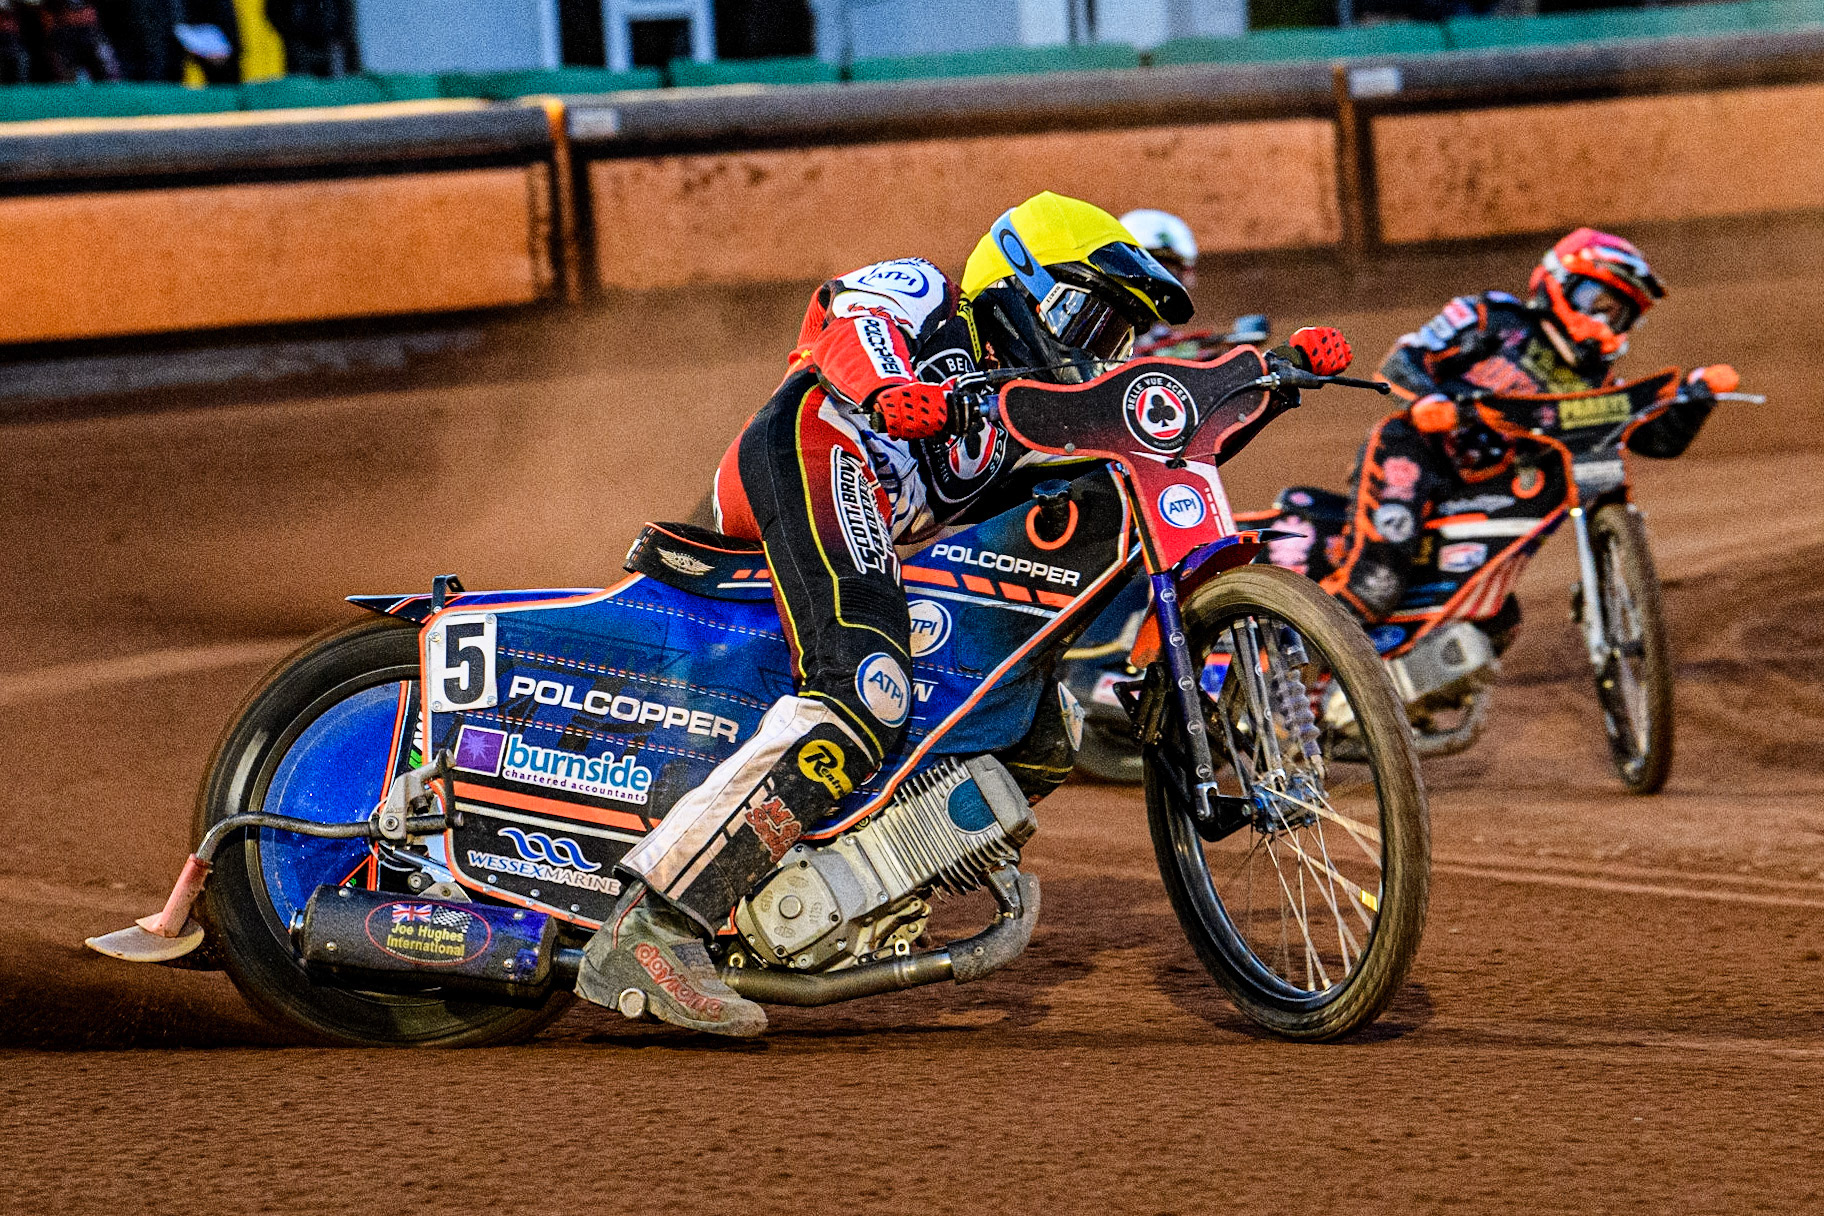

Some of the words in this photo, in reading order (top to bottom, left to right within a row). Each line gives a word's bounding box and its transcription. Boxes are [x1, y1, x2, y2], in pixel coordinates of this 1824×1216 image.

[867, 271, 917, 287] ATPI
[1127, 383, 1144, 411] BELLE
[1144, 377, 1163, 386] VUE
[1165, 381, 1188, 402] ACES
[1168, 497, 1198, 515] ATPI
[844, 505, 882, 571] SCOTT
[930, 543, 1081, 587] POLCOPPER
[910, 617, 938, 637] TPI
[443, 622, 485, 705] 5
[867, 670, 904, 709] ATPI
[508, 675, 740, 743] POLCOPPER
[506, 736, 649, 792] burnside
[505, 769, 567, 788] chartered
[571, 782, 646, 802] accountants
[386, 934, 465, 957] International
[391, 922, 415, 936] Joe
[418, 924, 464, 943] Hughes
